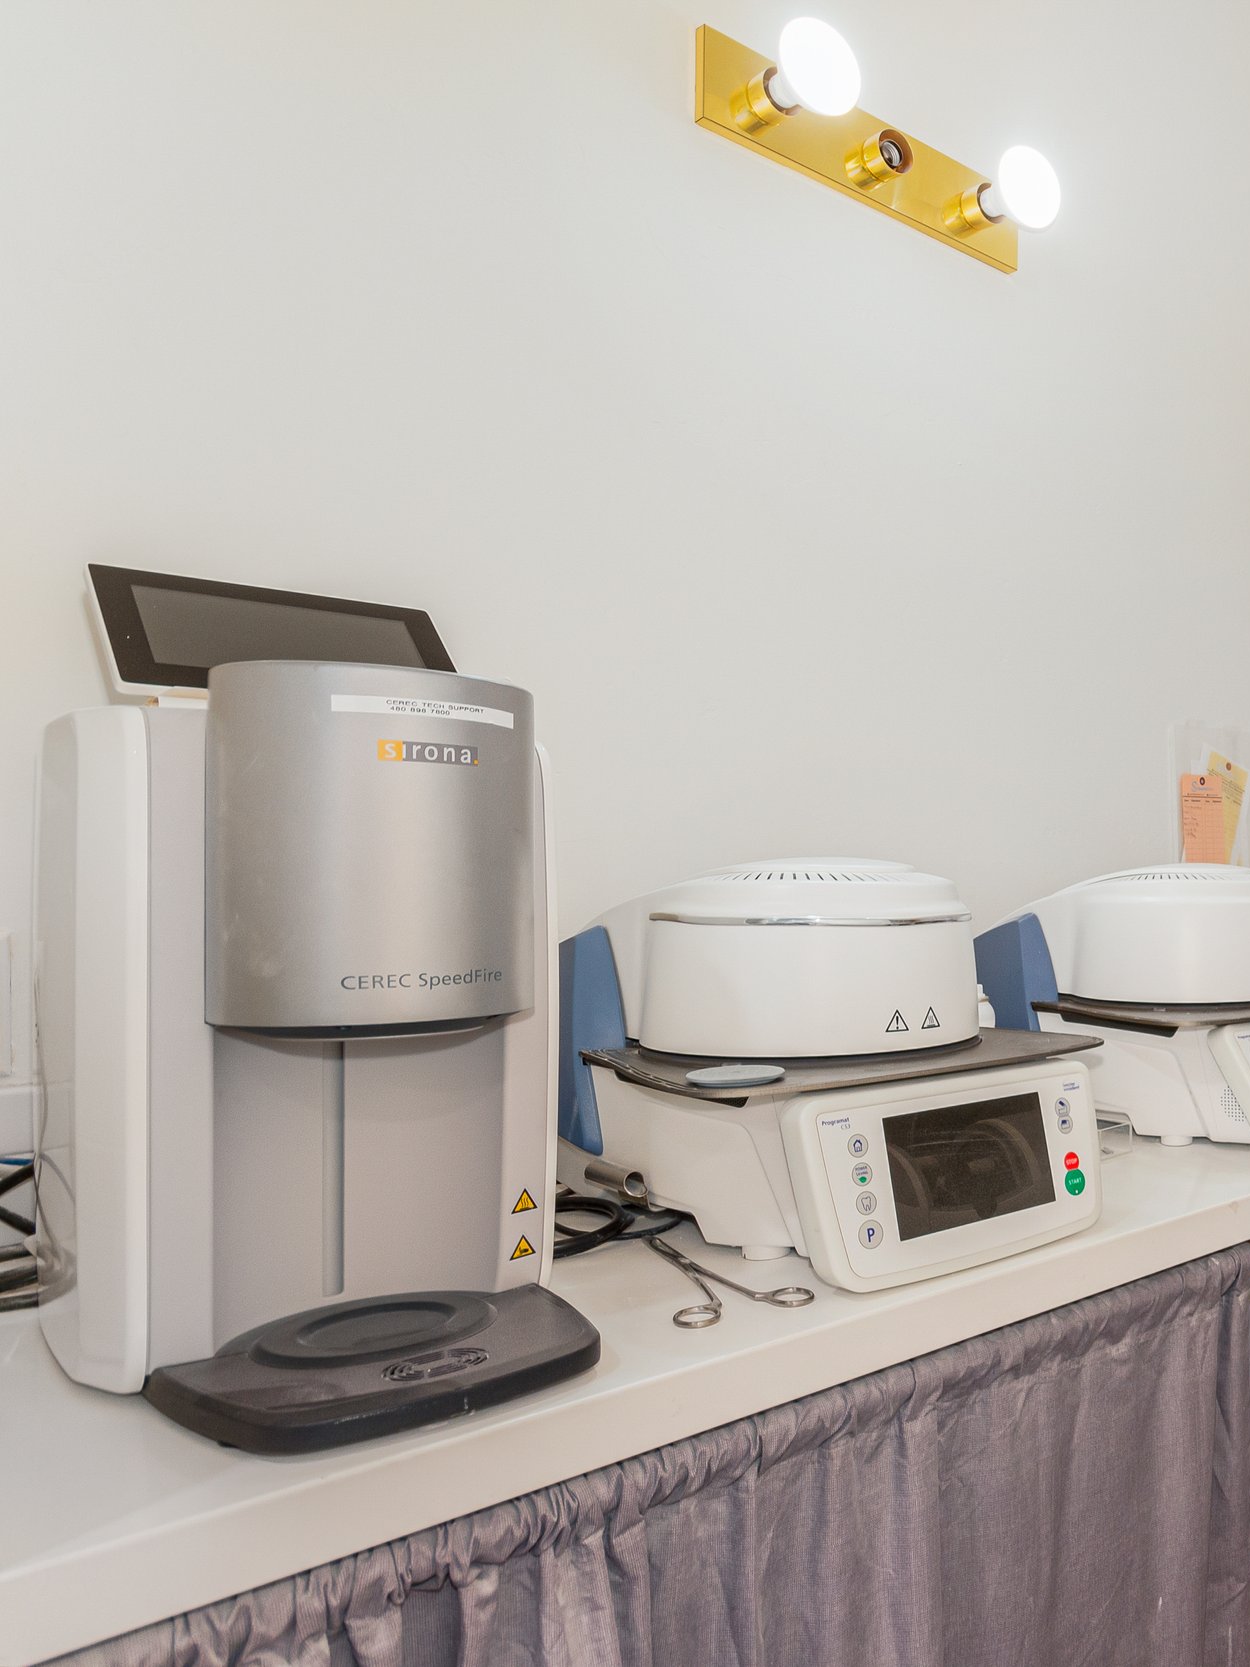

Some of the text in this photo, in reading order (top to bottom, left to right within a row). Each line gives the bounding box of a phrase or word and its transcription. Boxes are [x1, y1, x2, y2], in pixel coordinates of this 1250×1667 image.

[385, 699, 418, 707] CEREC
[448, 704, 484, 714] SUPPORT
[340, 968, 503, 991] CEREC SpeedFire
[821, 1116, 850, 1127] Programat
[1065, 1157, 1078, 1166] STOP
[1068, 1176, 1082, 1186] START
[866, 1227, 875, 1243] P
